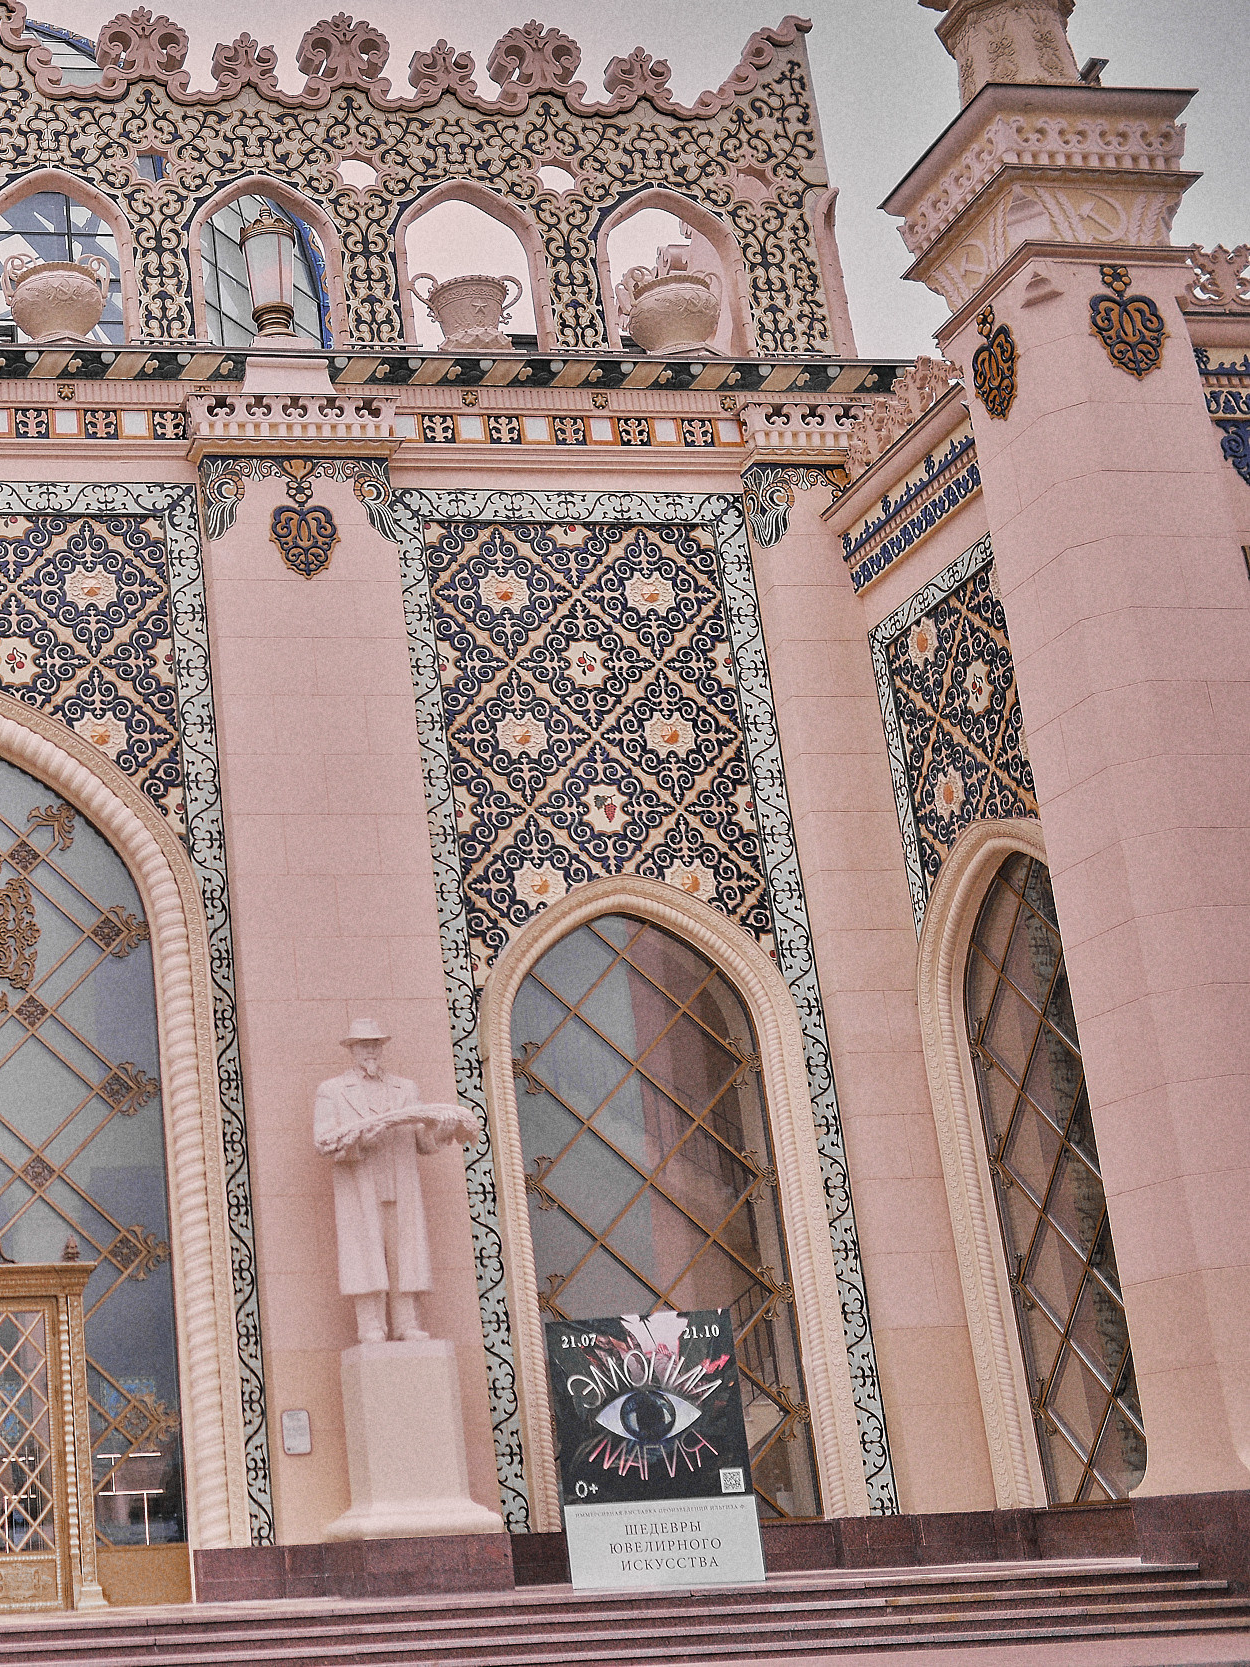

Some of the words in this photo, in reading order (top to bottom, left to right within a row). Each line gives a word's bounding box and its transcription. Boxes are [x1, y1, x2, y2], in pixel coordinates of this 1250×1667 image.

[683, 1324, 720, 1339] 21.10
[561, 1333, 597, 1349] 21.07
[588, 1428, 719, 1481] МАГИЯ
[575, 1480, 599, 1499] 0+
[625, 1521, 702, 1536] ШЕДЕВРЫ
[609, 1537, 722, 1555] ЮВЕЛИРНОГО
[621, 1556, 719, 1572] ИСКУССТВА
